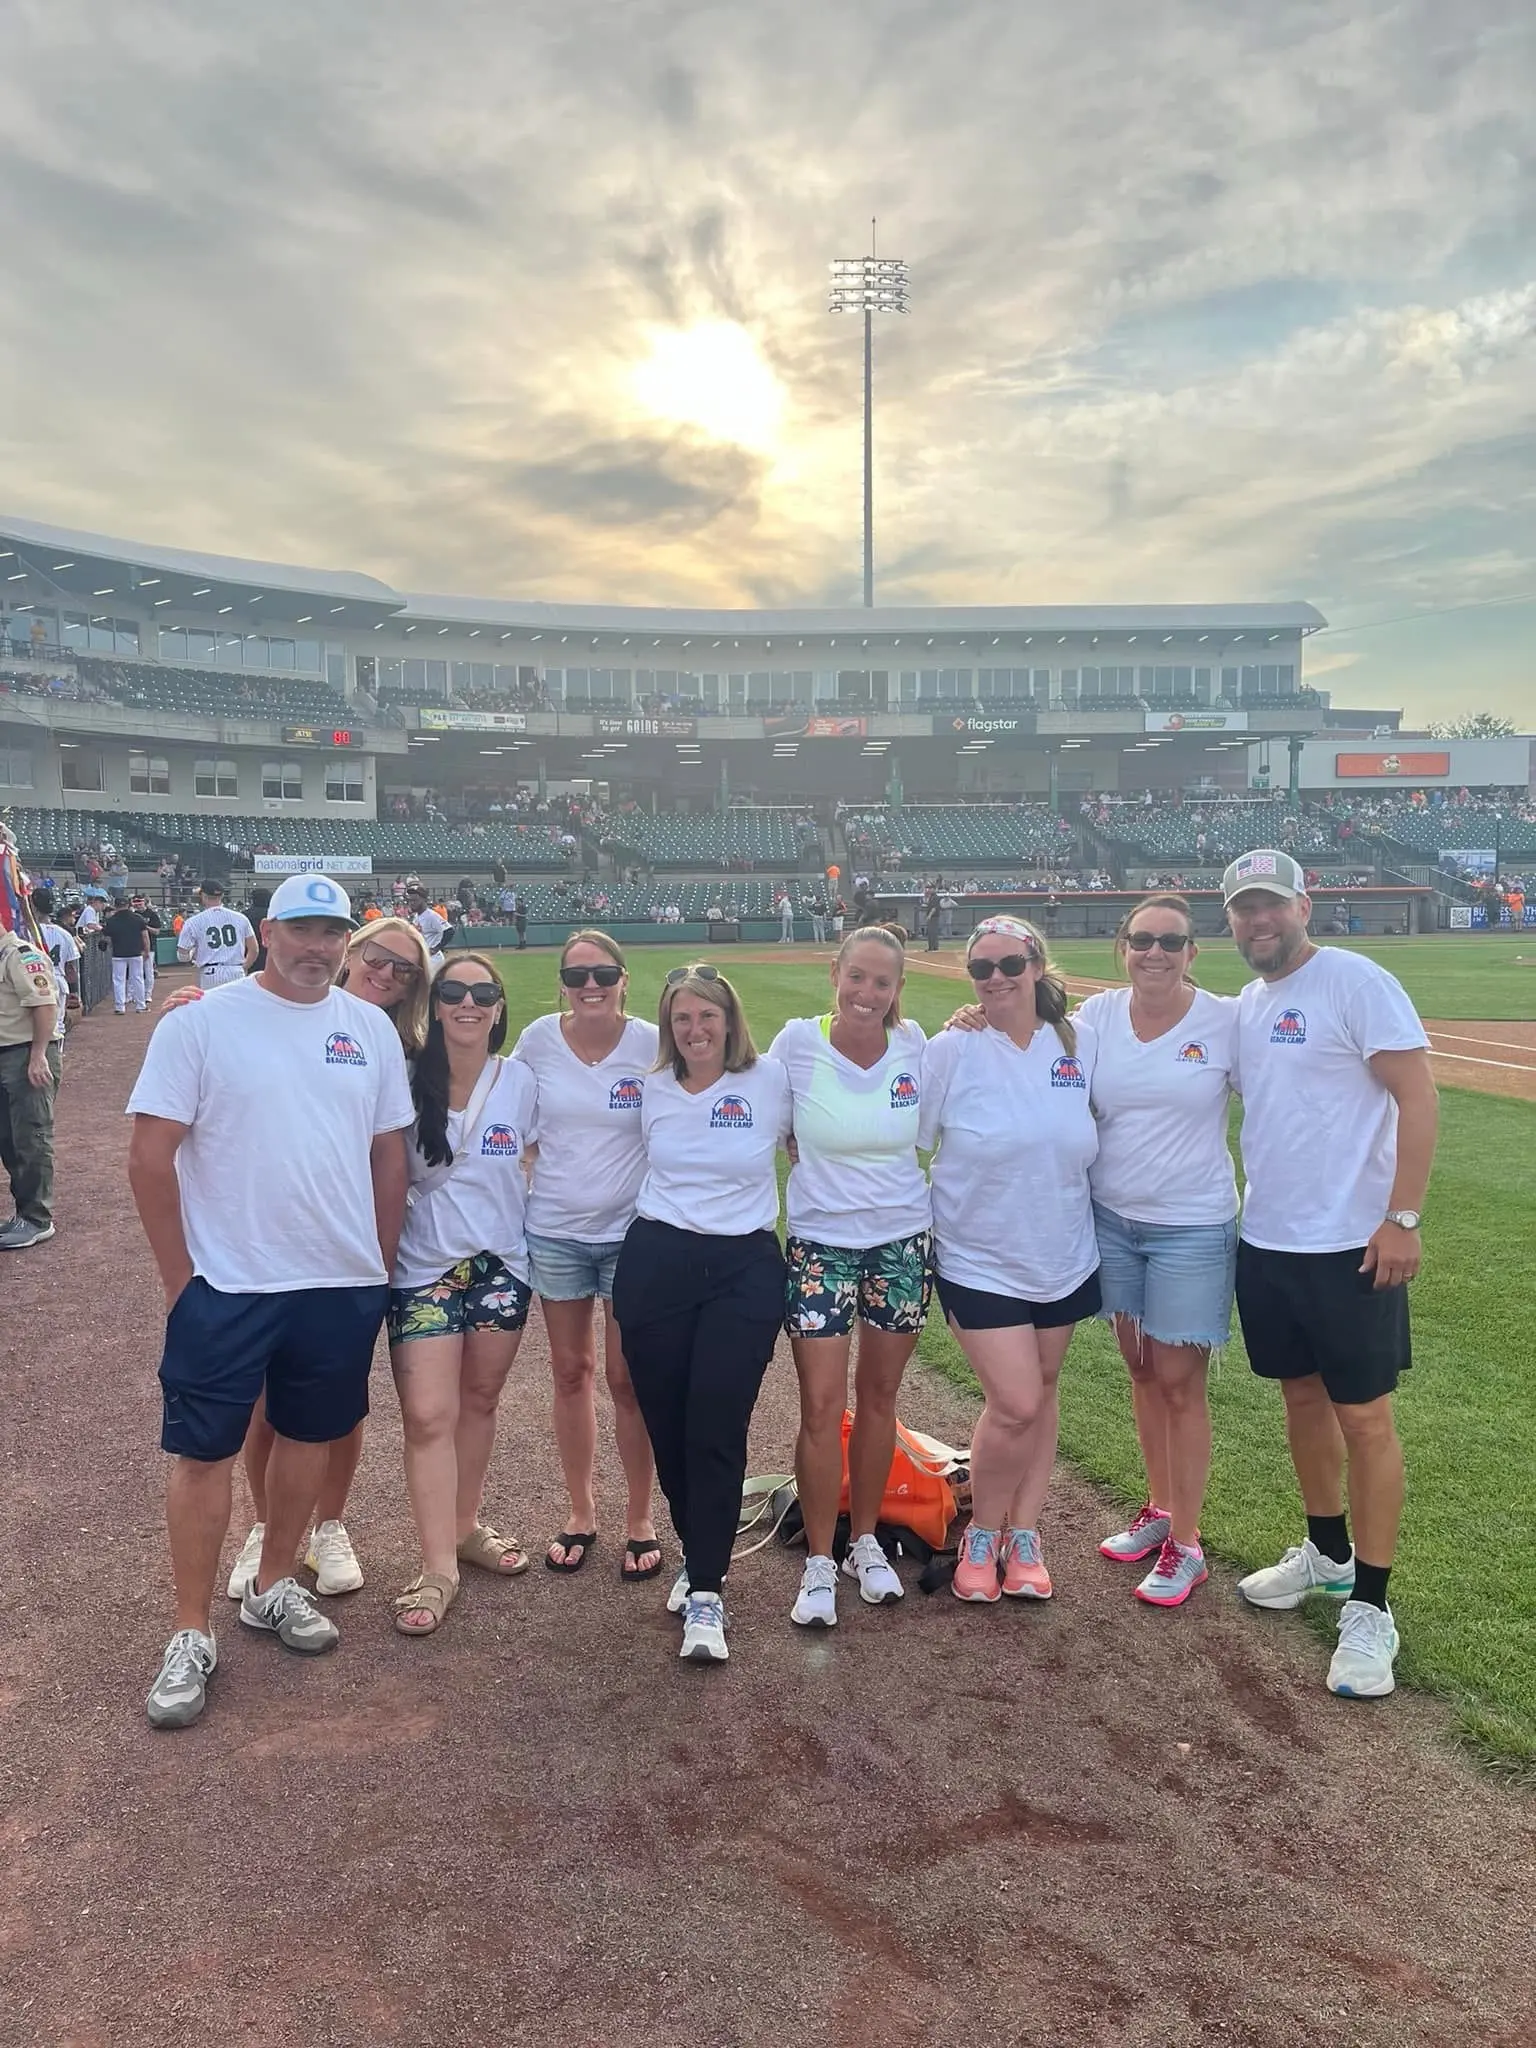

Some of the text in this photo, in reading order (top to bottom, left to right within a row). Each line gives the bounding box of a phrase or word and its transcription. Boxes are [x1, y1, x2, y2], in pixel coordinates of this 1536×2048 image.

[967, 717, 1018, 732] flagstar
[257, 858, 324, 872] nationalgrid
[206, 924, 238, 950] 30
[712, 1107, 753, 1122] Malibu
[710, 1120, 754, 1129] BEACH CAMP
